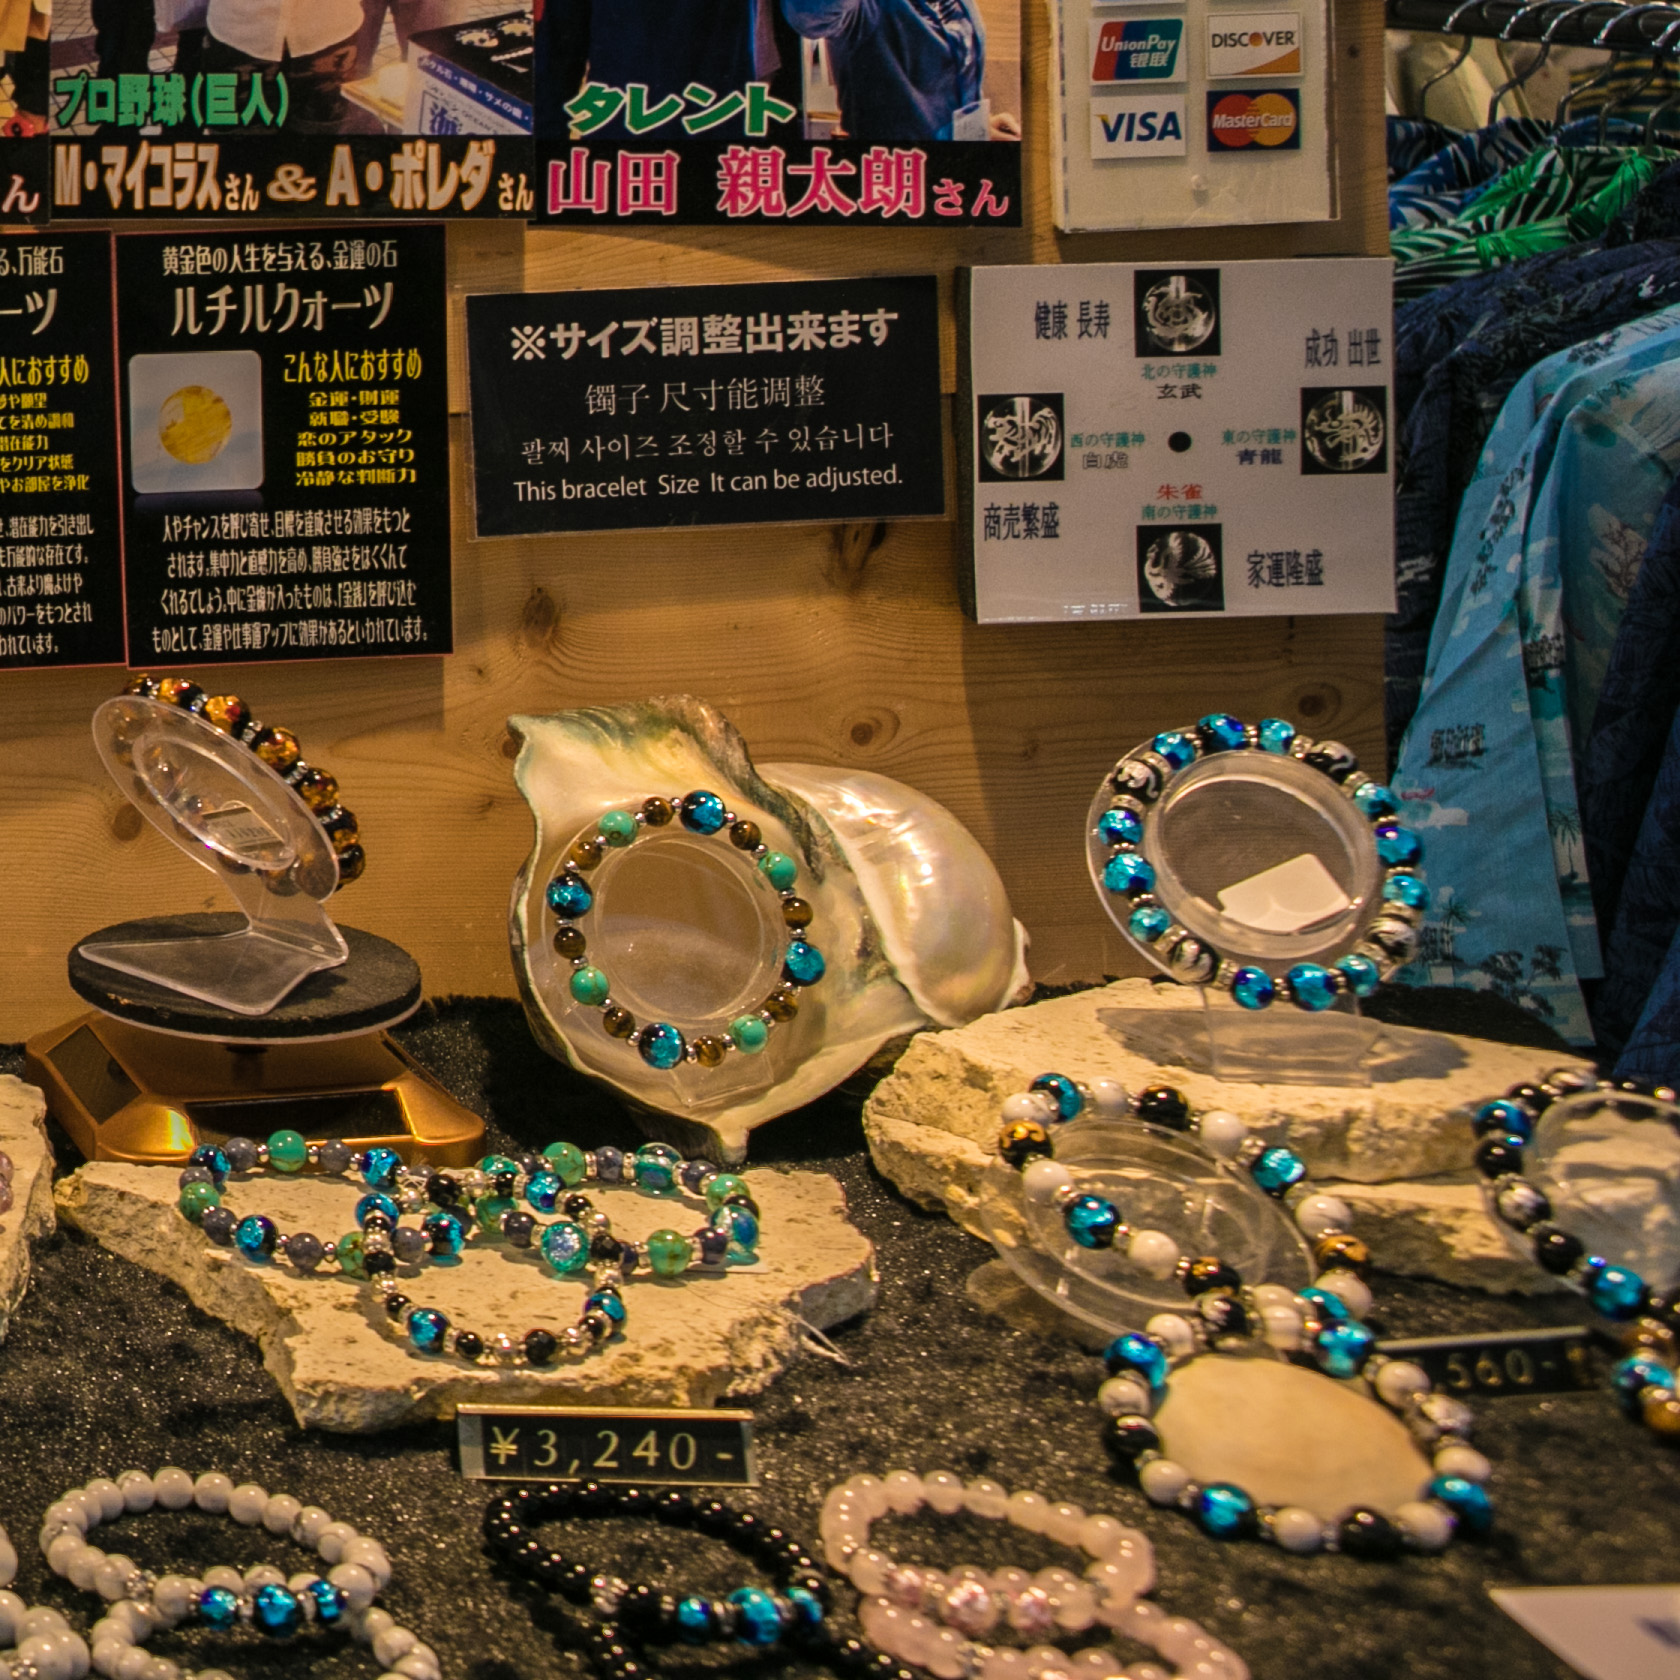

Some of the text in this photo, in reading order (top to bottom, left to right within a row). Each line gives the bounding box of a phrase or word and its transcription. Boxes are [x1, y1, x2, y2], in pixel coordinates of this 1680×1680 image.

[1101, 35, 1176, 53] UnionPay
[1212, 31, 1295, 48] DISCOVER
[56, 71, 289, 127] プロ野球(巨人)
[564, 81, 796, 136] タレント
[1094, 111, 1182, 143] VISA
[1212, 112, 1293, 129] MasterCard
[267, 163, 317, 202] &
[548, 144, 1009, 218] 山田 親太朗さん
[162, 240, 398, 276] 黄金色の人生を与える、金運の石
[171, 282, 393, 336] ルチルクォーツ
[1034, 300, 1110, 341] 健康 長寿
[511, 309, 898, 361] ※サイズ調整出来ます
[1305, 328, 1381, 369] 成功 出世
[284, 348, 422, 383] こんな人におすすめ
[1141, 363, 1217, 380] 北の守護神
[1157, 384, 1202, 400] 玄武
[521, 423, 894, 465] 팔찌 사이즈 조정할 수 있습니다
[1070, 432, 1145, 448] 西の守護神
[1221, 429, 1296, 446] 東の守護神
[296, 448, 415, 467] 勝負のお守り
[1236, 449, 1282, 466] 青龍
[296, 468, 416, 486] 冷静な判断力
[513, 464, 903, 502] This bracelet Size It can be adjusted.
[1156, 484, 1203, 499] 朱雀
[983, 502, 1059, 541] 商売繁盛
[1142, 504, 1218, 520] 南の守護神
[1246, 550, 1324, 588] 家運隆盛
[490, 1427, 733, 1475] ¥3,240-
